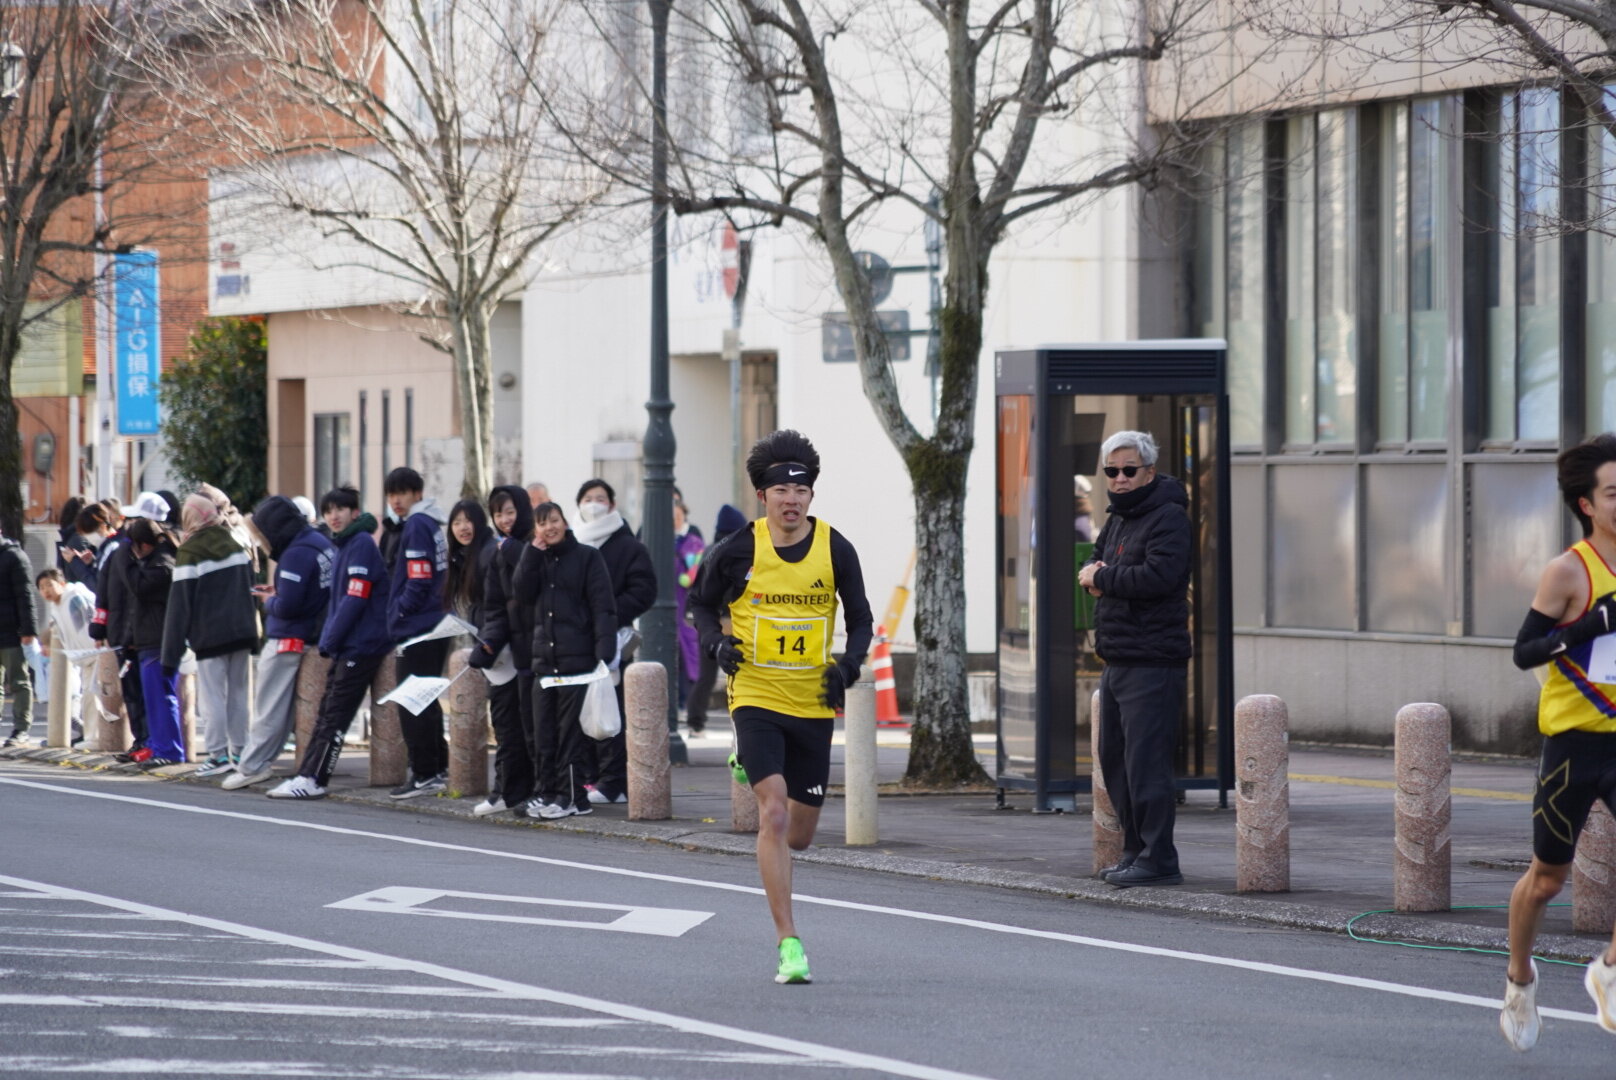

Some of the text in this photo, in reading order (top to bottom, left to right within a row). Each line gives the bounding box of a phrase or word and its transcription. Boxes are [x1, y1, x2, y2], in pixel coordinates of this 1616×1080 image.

[128, 288, 149, 397] AIG損保
[765, 593, 830, 605] LOGISTEED
[776, 635, 806, 655] 14
